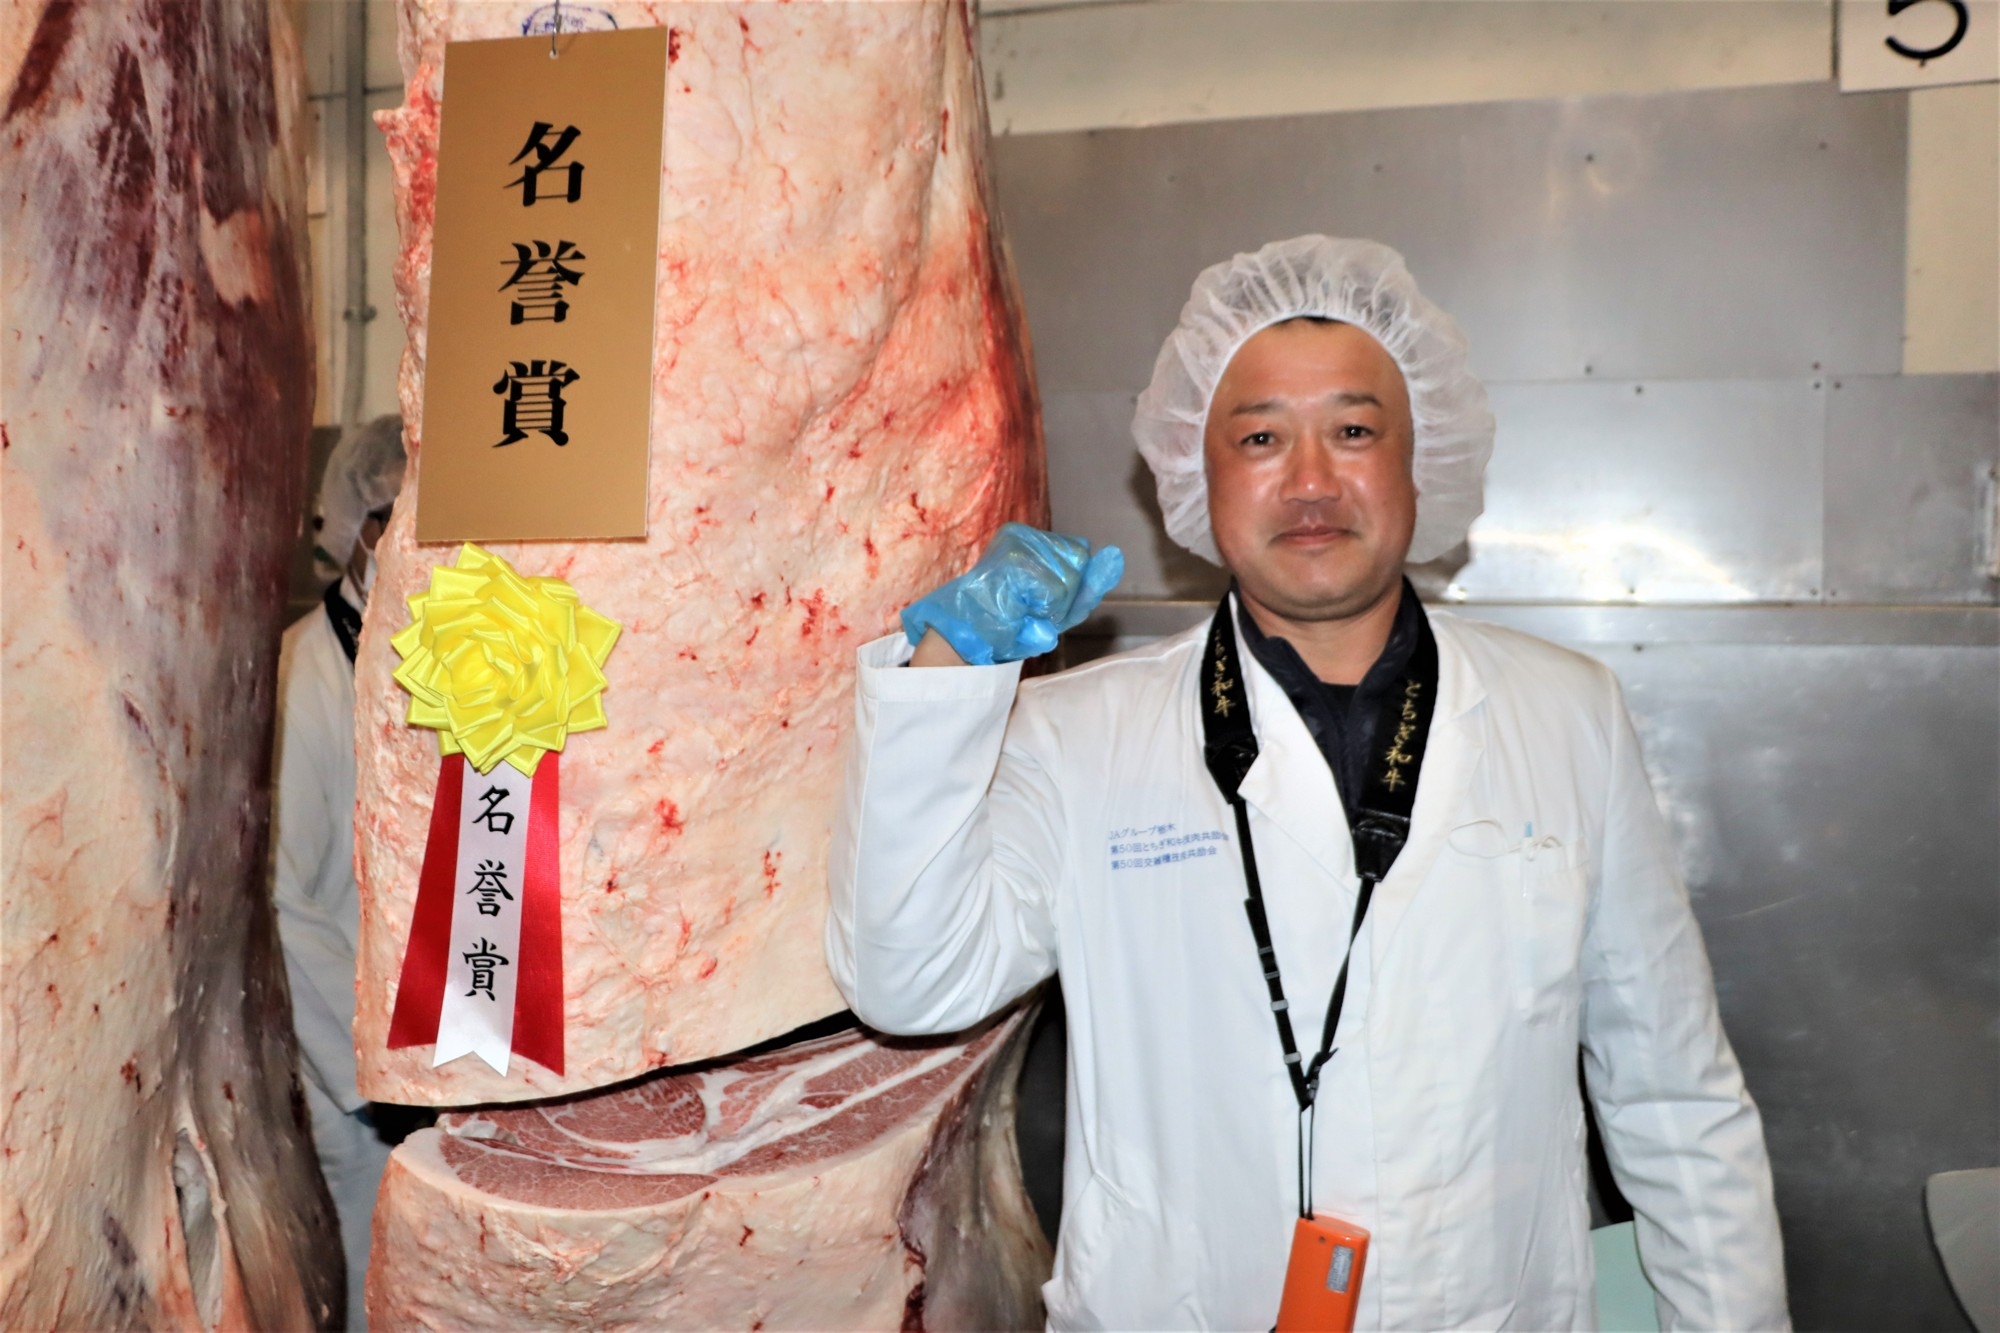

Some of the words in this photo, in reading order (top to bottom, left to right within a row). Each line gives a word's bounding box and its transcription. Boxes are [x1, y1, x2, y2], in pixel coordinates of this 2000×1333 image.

[1885, 0, 1969, 60] 5
[492, 121, 586, 448] 名誉賞
[1381, 679, 1421, 792] とちぎ和牛
[462, 784, 515, 1001] 名誉賞
